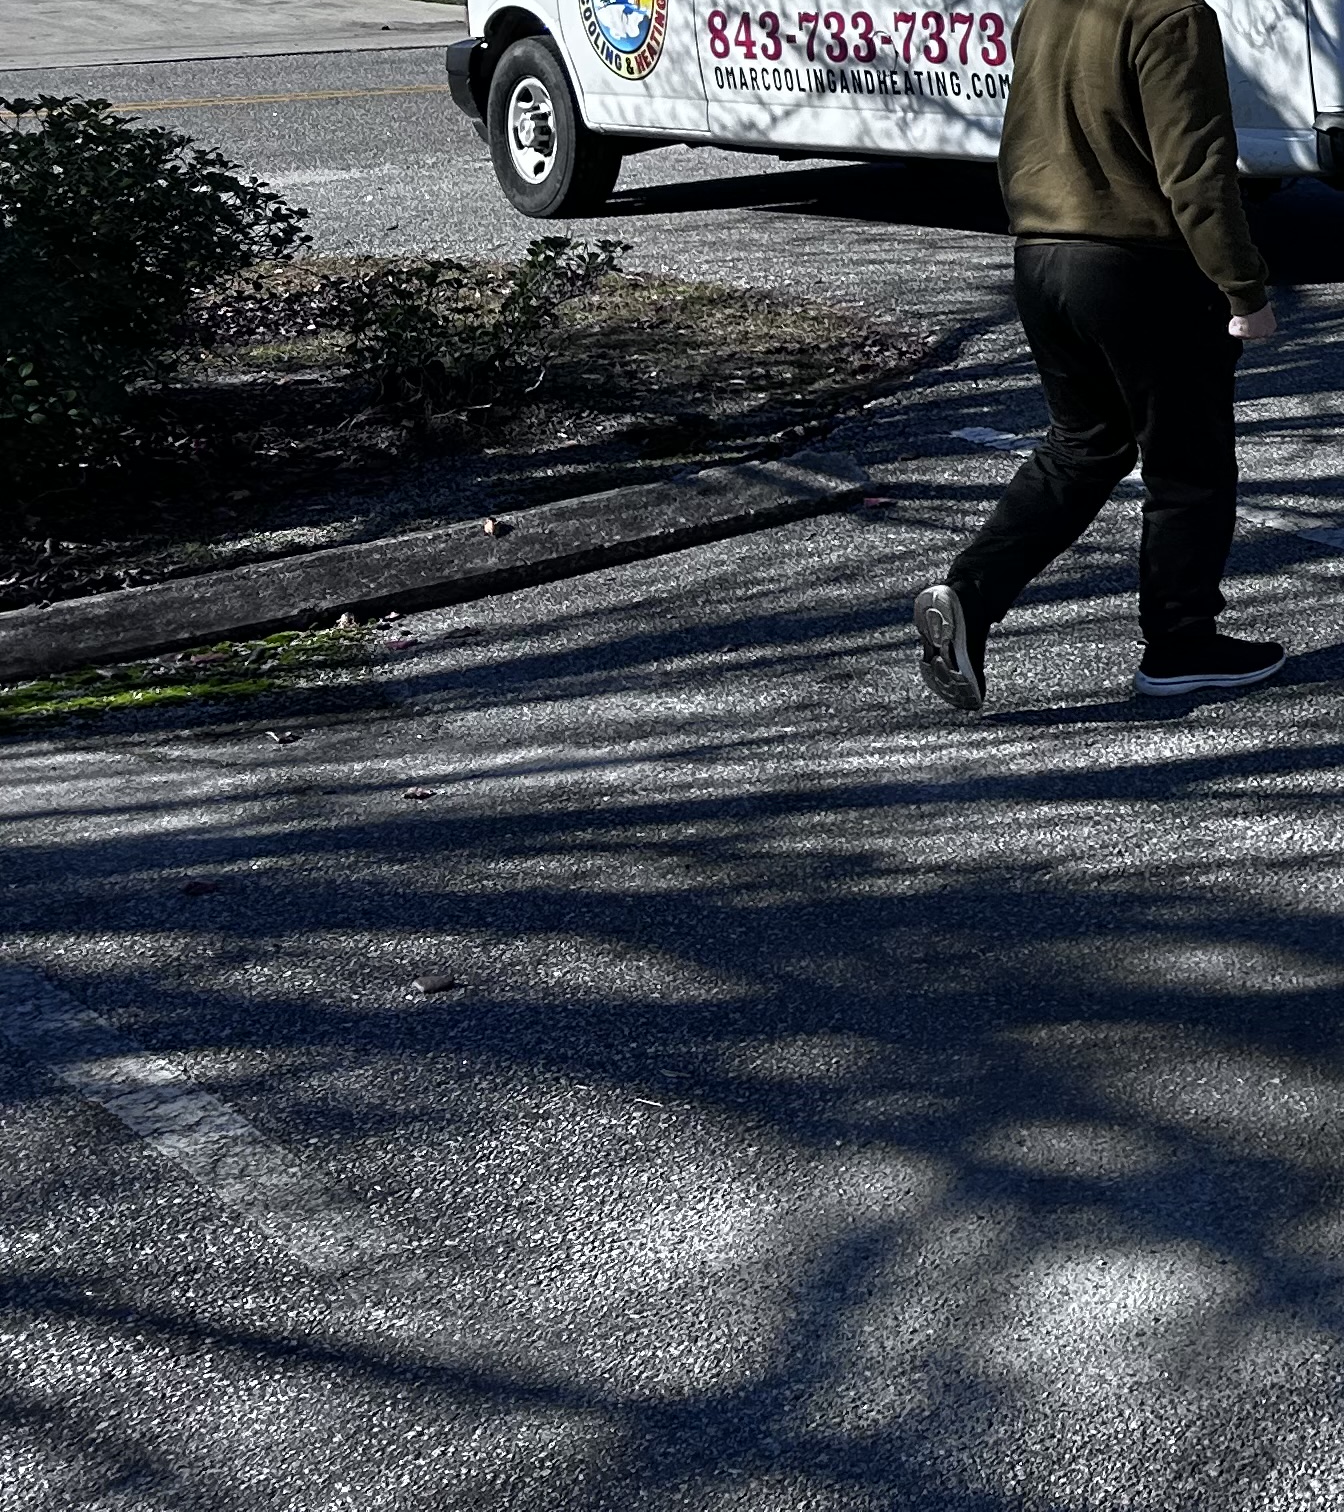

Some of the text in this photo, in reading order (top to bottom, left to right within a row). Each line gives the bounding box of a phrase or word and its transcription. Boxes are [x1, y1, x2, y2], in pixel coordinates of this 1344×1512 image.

[707, 9, 1007, 66] 843-733-7373
[626, 57, 634, 74] &
[715, 66, 1010, 100] OMARCOOLINGANDHEATING.COM
